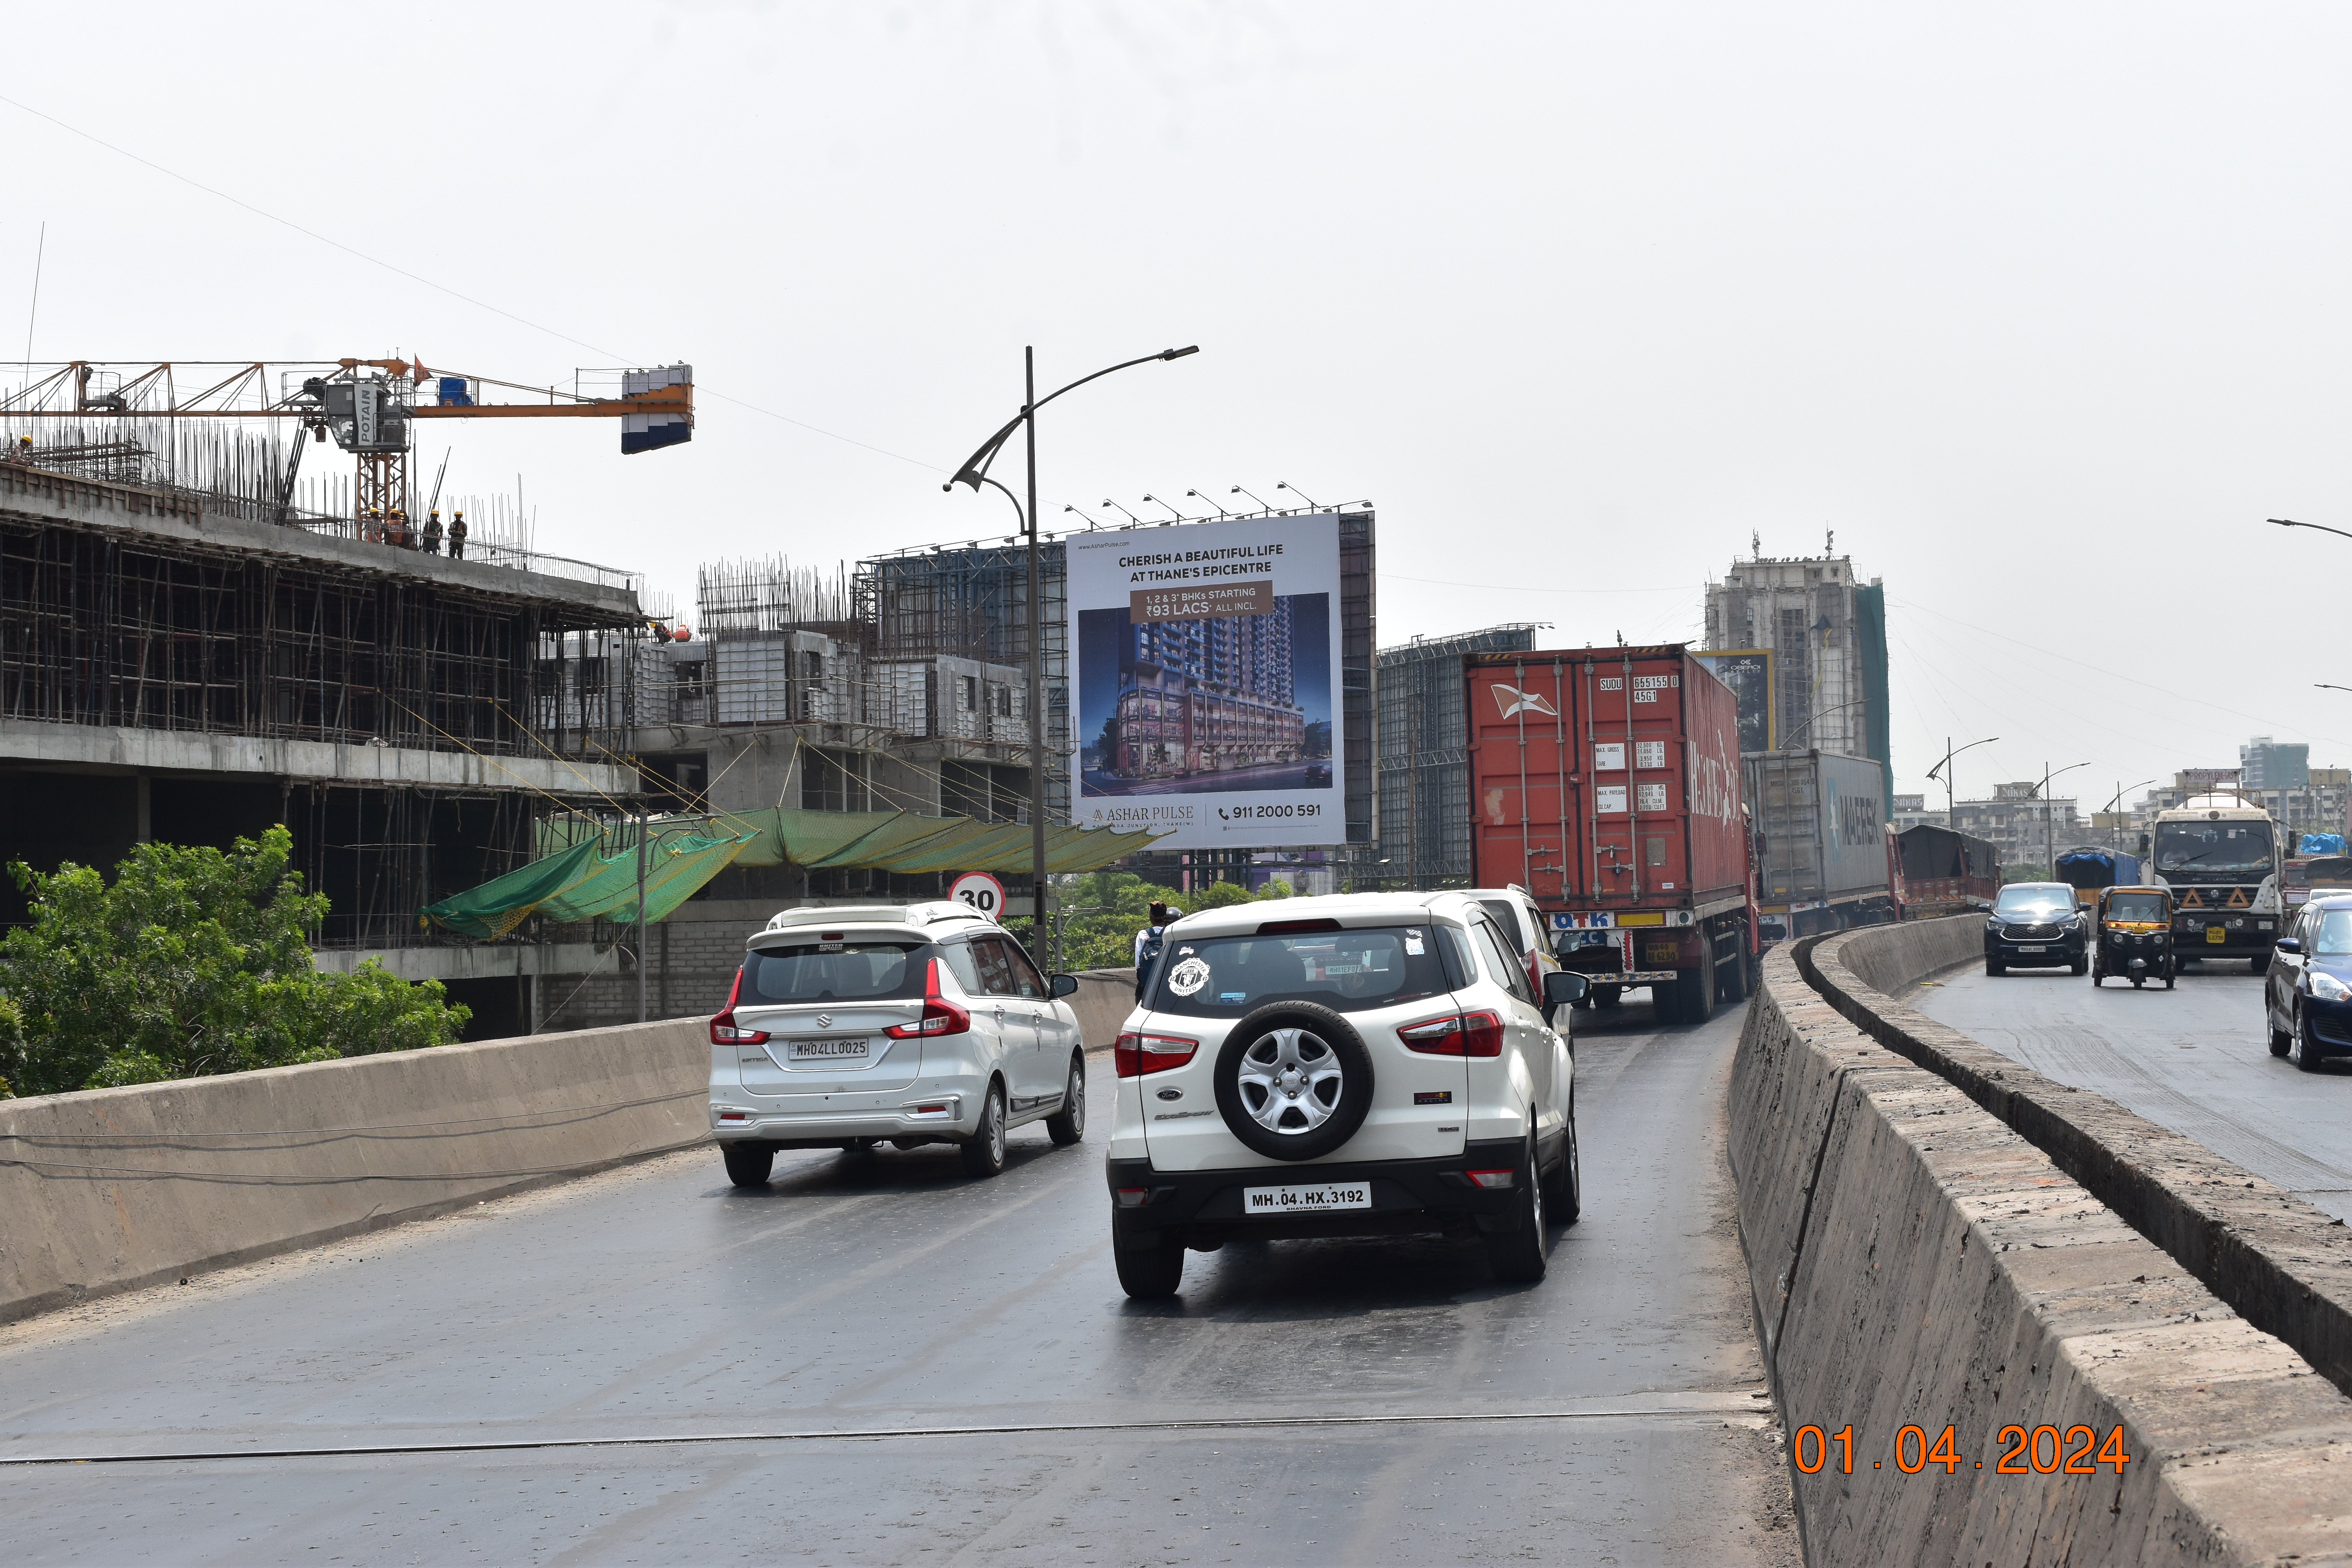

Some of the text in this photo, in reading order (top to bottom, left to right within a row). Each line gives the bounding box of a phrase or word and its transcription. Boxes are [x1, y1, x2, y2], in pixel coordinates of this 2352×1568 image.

[361, 390, 370, 442] POTAIN
[1119, 544, 1283, 568] CHERISH A BEAUTIFUL LIFE
[1130, 561, 1272, 583] AT THANE'S EPICENTRE
[1146, 596, 1152, 604] 1,
[1181, 592, 1206, 601] BHKs
[1209, 588, 1256, 599] STARTING
[1147, 604, 1169, 617] ₹93
[1235, 602, 1256, 610] INCL.
[1601, 676, 1677, 689] SUDU 655155 0
[1635, 691, 1656, 701] 45G1
[1107, 806, 1193, 821] ASHAR PULSE
[1233, 804, 1321, 818] 911 2000 591
[959, 889, 994, 911] 30
[1175, 961, 1206, 973] MANCHESTER
[797, 1042, 866, 1056] MH04LL0025
